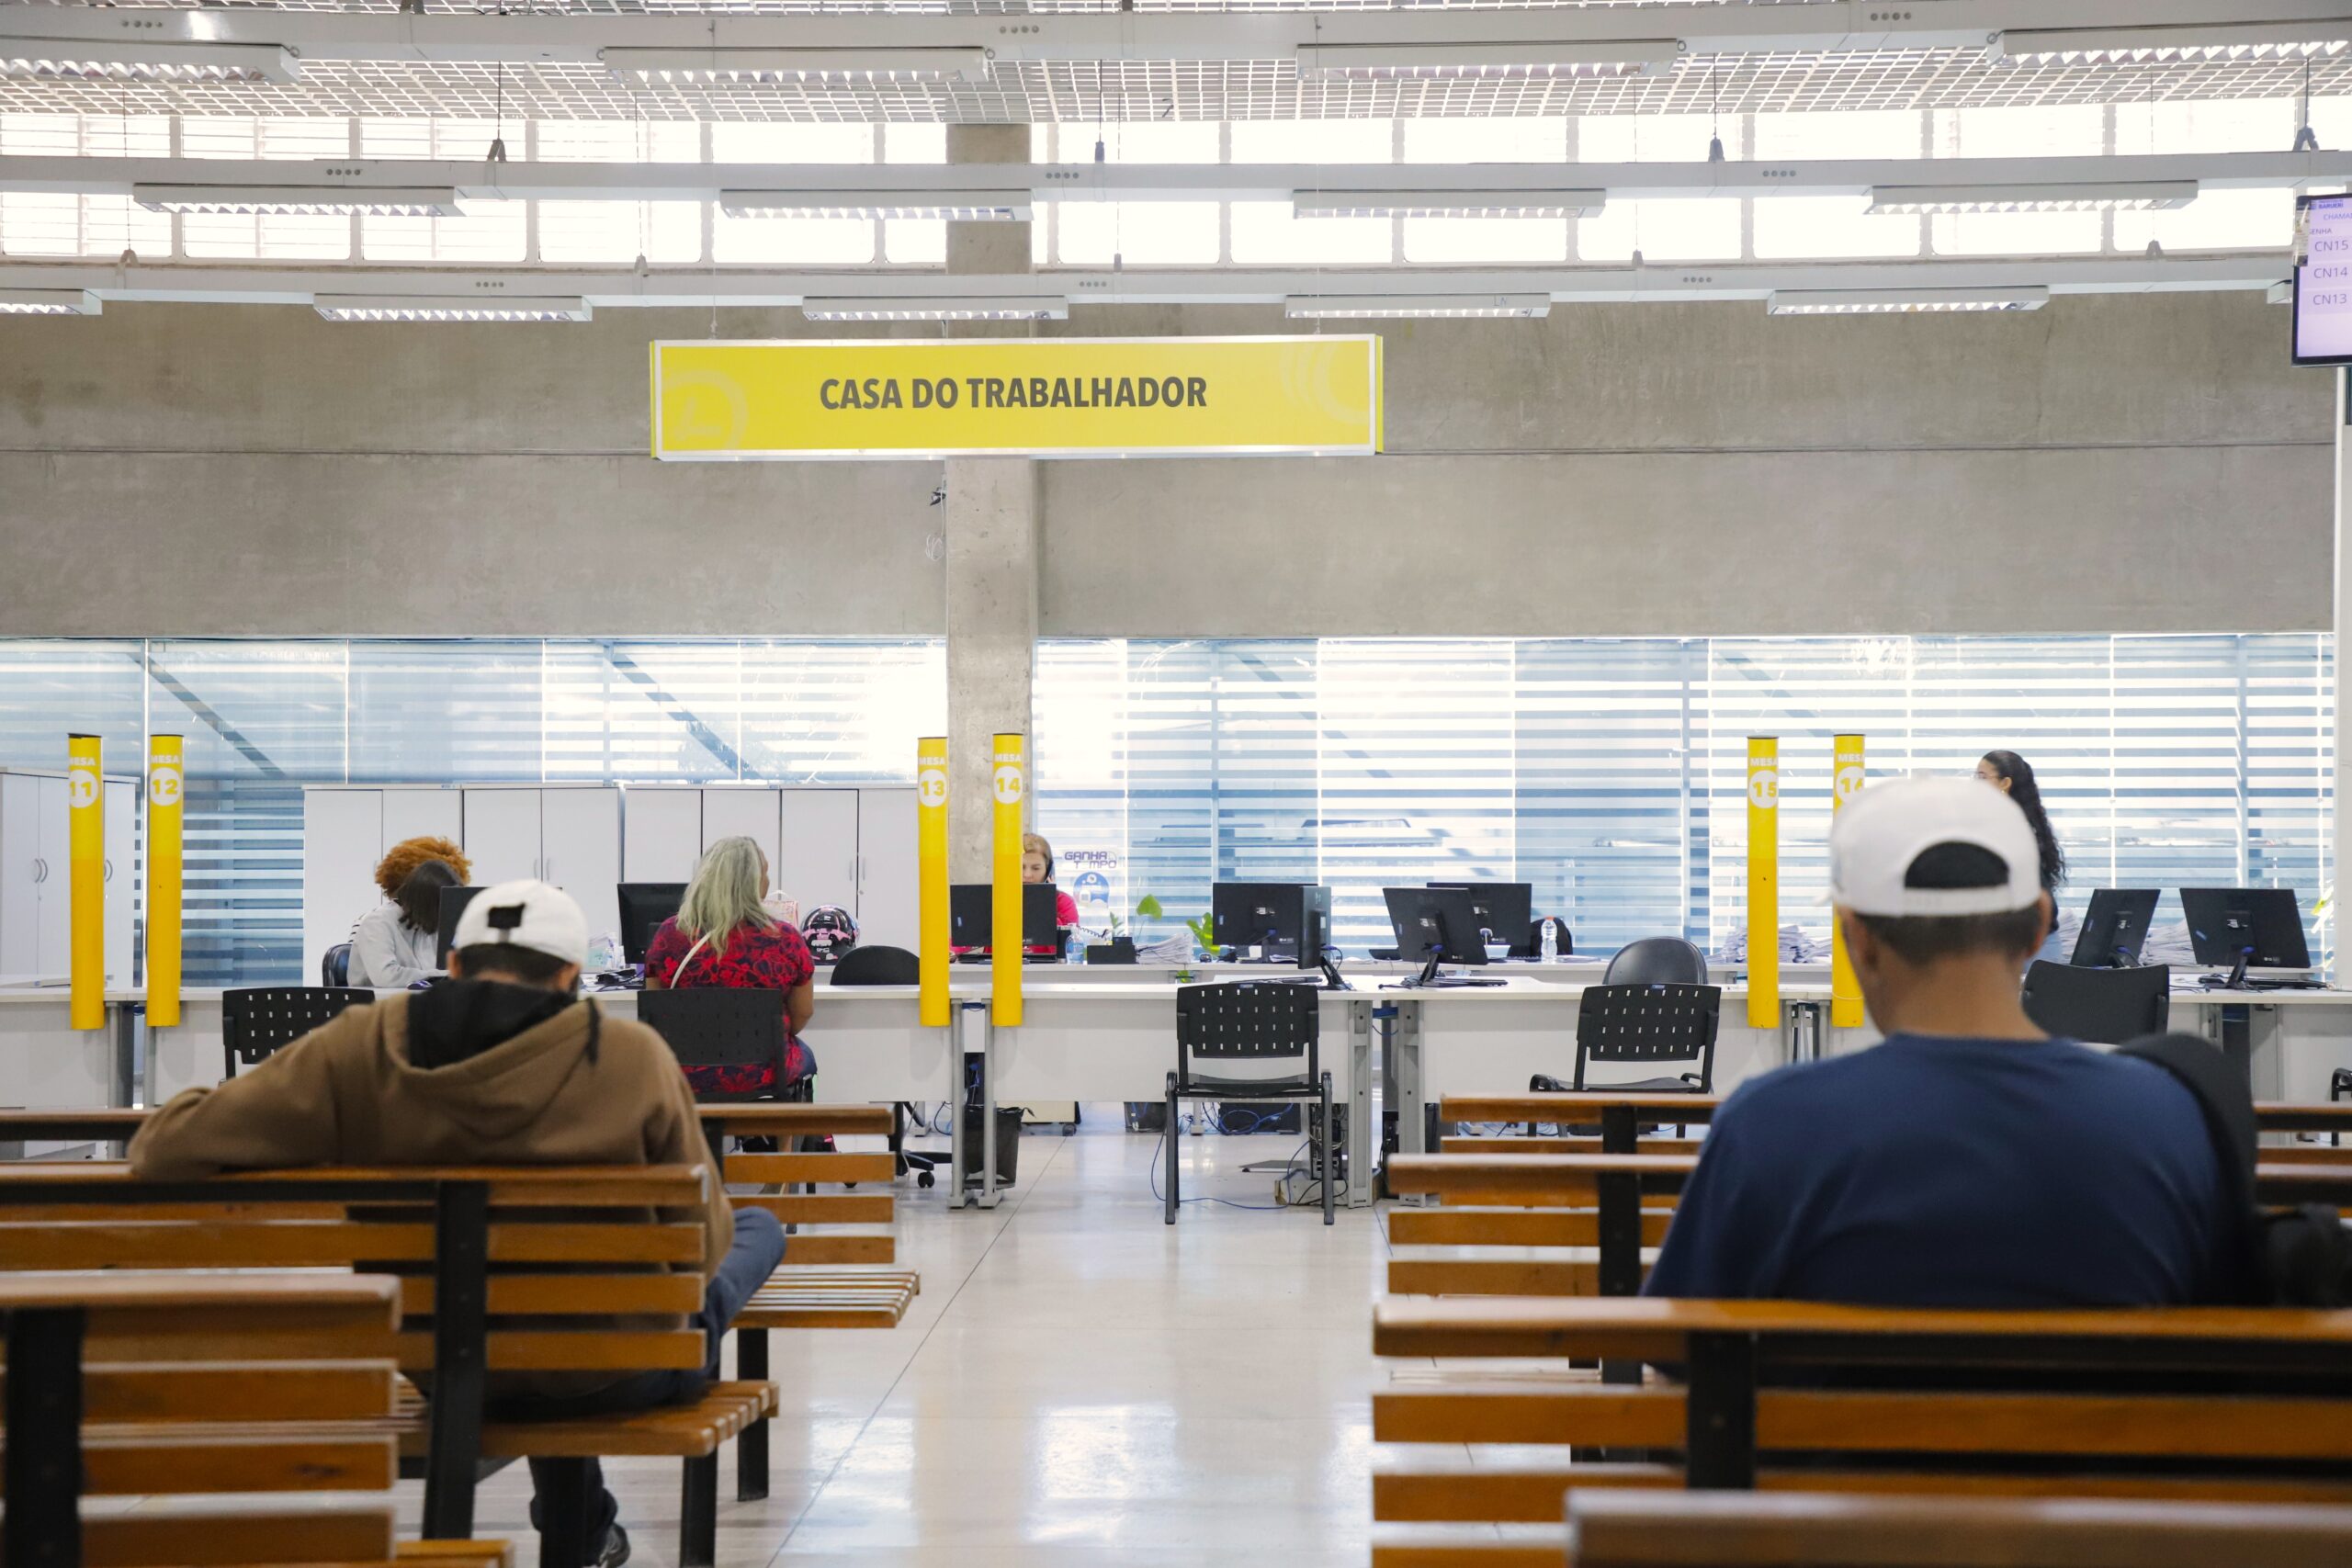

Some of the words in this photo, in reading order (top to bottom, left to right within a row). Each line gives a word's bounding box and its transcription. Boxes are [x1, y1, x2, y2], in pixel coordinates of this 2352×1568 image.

[2314, 240, 2349, 252] CN15
[2313, 266, 2348, 279] CN14
[2312, 293, 2347, 306] CN13
[820, 378, 903, 410] CASA
[911, 378, 958, 409] DO
[966, 377, 1207, 408] TRABALHADOR
[150, 755, 180, 763] MESA
[919, 757, 945, 765] MESA
[994, 753, 1022, 762] MESA
[69, 781, 92, 797] 11
[152, 779, 178, 795] 12
[921, 780, 945, 796] 13
[996, 777, 1021, 793] 14
[1753, 781, 1777, 797] 15
[1064, 851, 1108, 861] GANHA
[1073, 860, 1117, 869] TMPO
